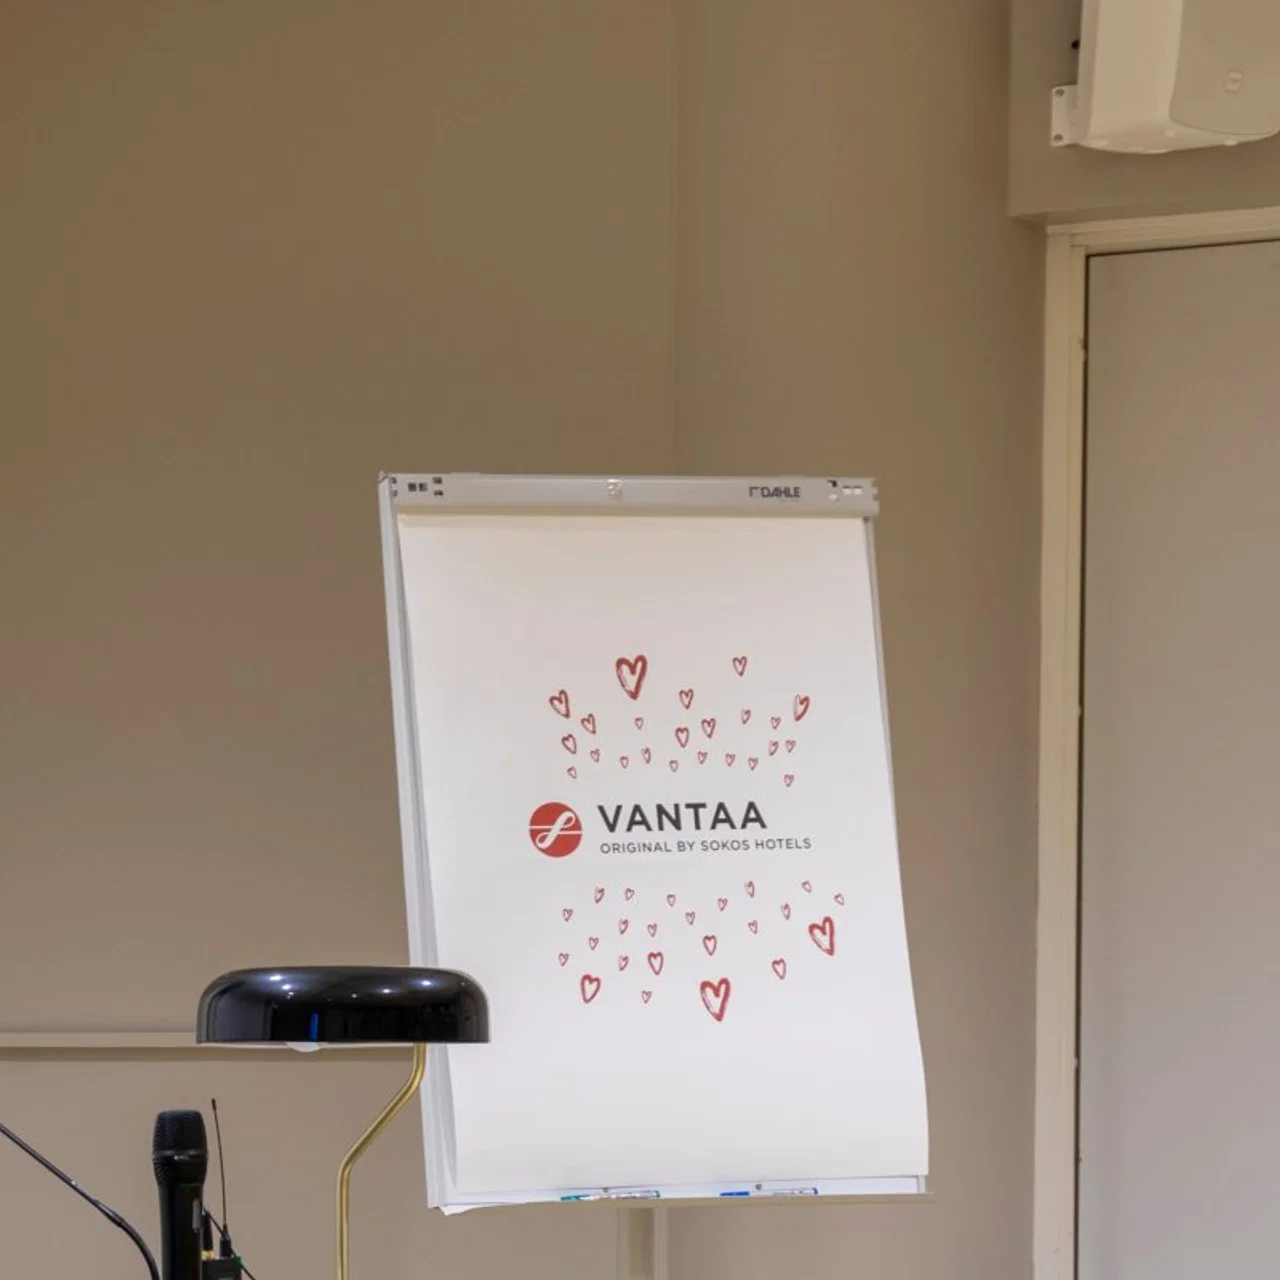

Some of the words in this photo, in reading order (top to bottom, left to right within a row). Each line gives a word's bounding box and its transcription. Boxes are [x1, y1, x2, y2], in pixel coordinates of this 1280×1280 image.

[761, 486, 801, 498] DAHLE
[597, 801, 767, 833] VANTAA
[600, 841, 672, 854] ORIGINAL
[677, 840, 695, 852] BY
[700, 840, 750, 851] SOKOS
[754, 838, 812, 850] HOTELS
